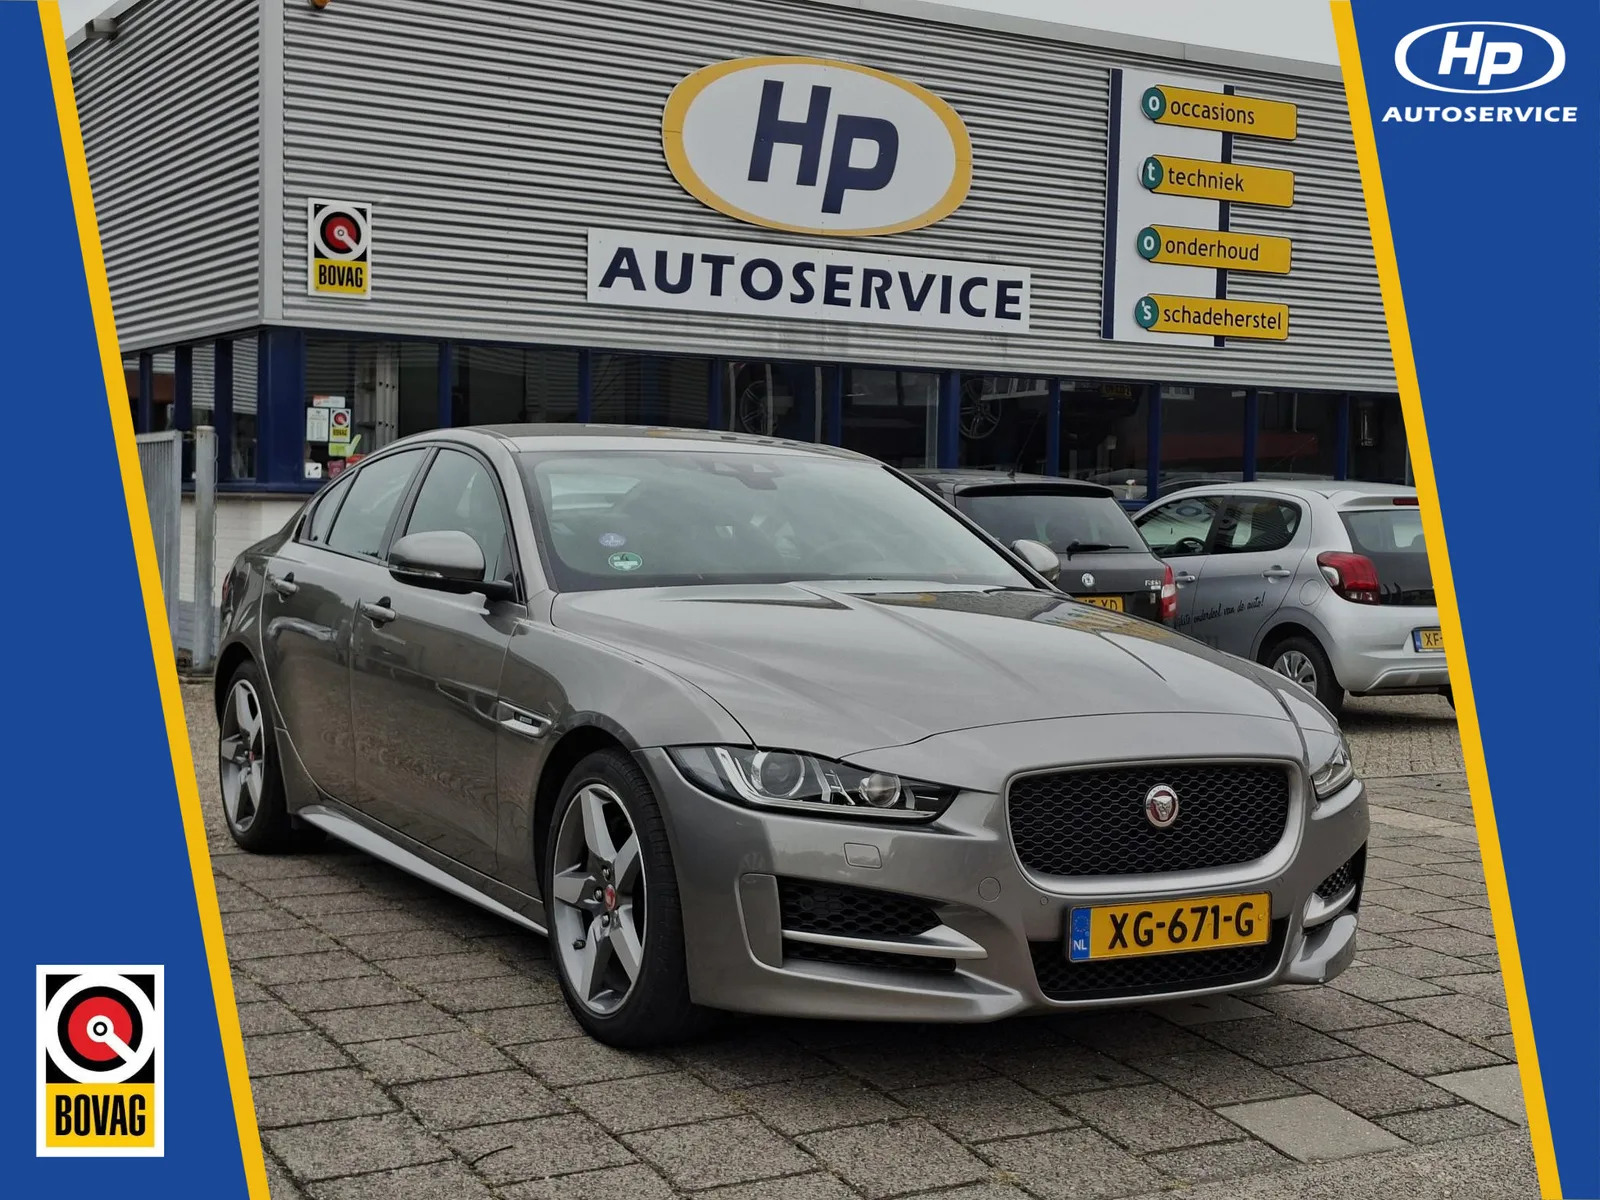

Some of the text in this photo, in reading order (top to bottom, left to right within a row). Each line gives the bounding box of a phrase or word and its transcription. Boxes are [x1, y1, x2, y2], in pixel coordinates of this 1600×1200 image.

[1170, 101, 1255, 125] occasions
[1147, 162, 1244, 192] t techniek
[1165, 238, 1259, 261] onderhoud
[318, 264, 363, 288] BOVAG
[598, 246, 1023, 320] AUTOSERVICE
[1163, 305, 1281, 330] schadeherstel
[1223, 606, 1235, 616] van
[1073, 902, 1254, 951] NL XG-671-G
